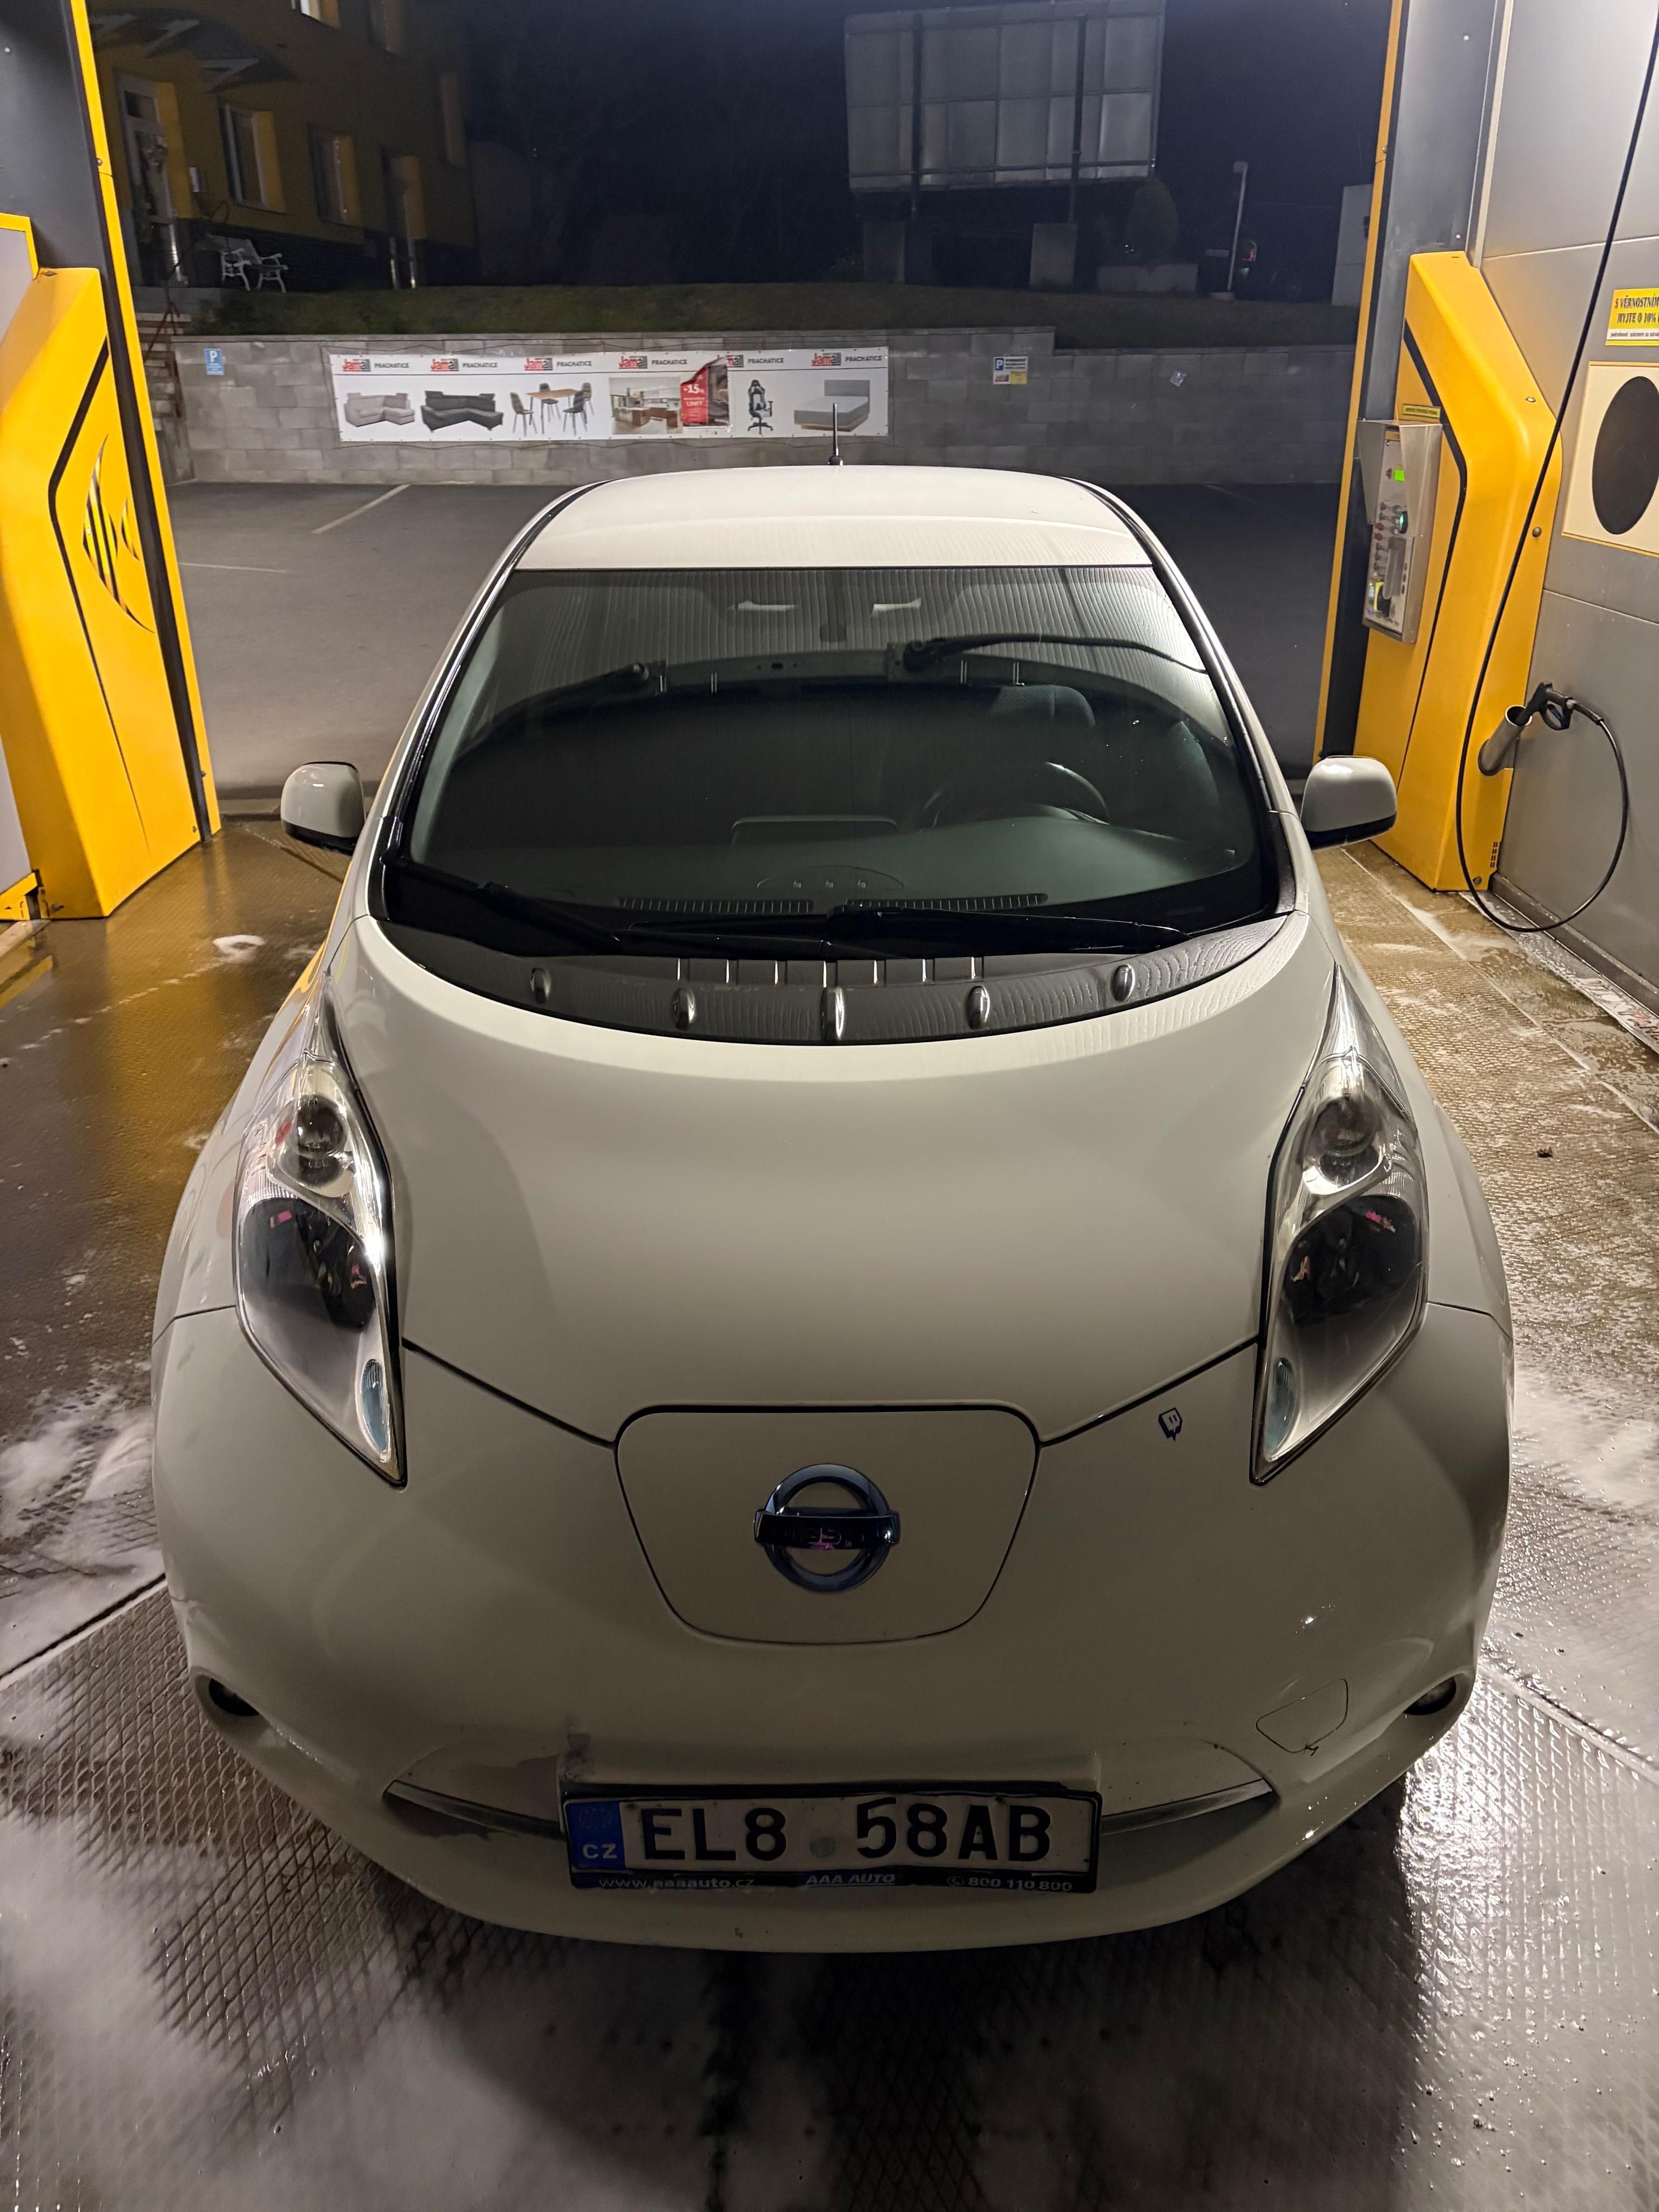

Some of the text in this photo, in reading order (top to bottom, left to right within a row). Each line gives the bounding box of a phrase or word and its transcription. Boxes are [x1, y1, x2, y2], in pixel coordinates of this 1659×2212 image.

[1614, 298, 1618, 308] S
[1617, 312, 1656, 323] MYJTE O 10%
[209, 350, 218, 362] P
[996, 359, 1003, 369] P
[641, 1797, 1051, 1862] EL8 58AB
[582, 1843, 617, 1859] CZ
[598, 1878, 755, 1889] www.aaaauto.cz
[805, 1873, 896, 1885] AAA AUTO
[968, 1877, 1073, 1891] 800 110 800
